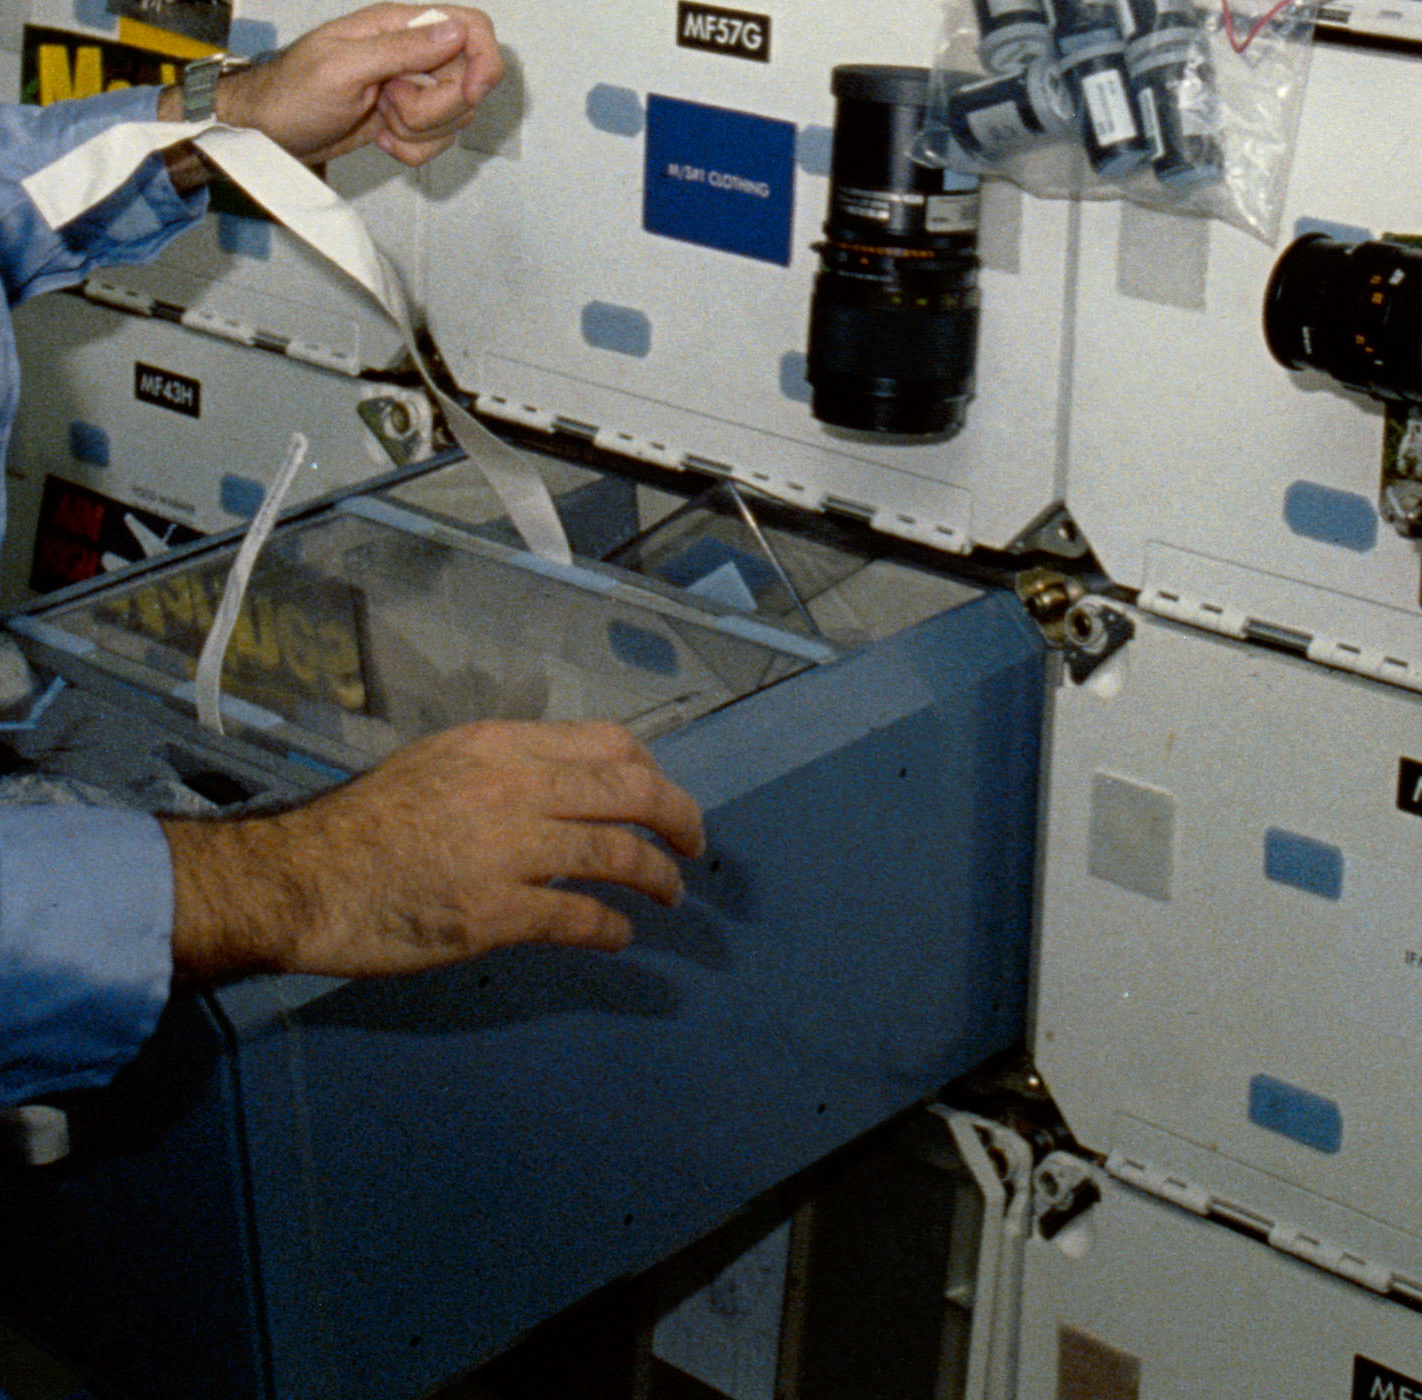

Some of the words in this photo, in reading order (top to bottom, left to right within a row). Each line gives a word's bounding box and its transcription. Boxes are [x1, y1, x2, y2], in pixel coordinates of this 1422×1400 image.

[683, 11, 763, 50] MF57G
[708, 170, 770, 200] CLOTHING
[140, 372, 193, 407] MF43H
